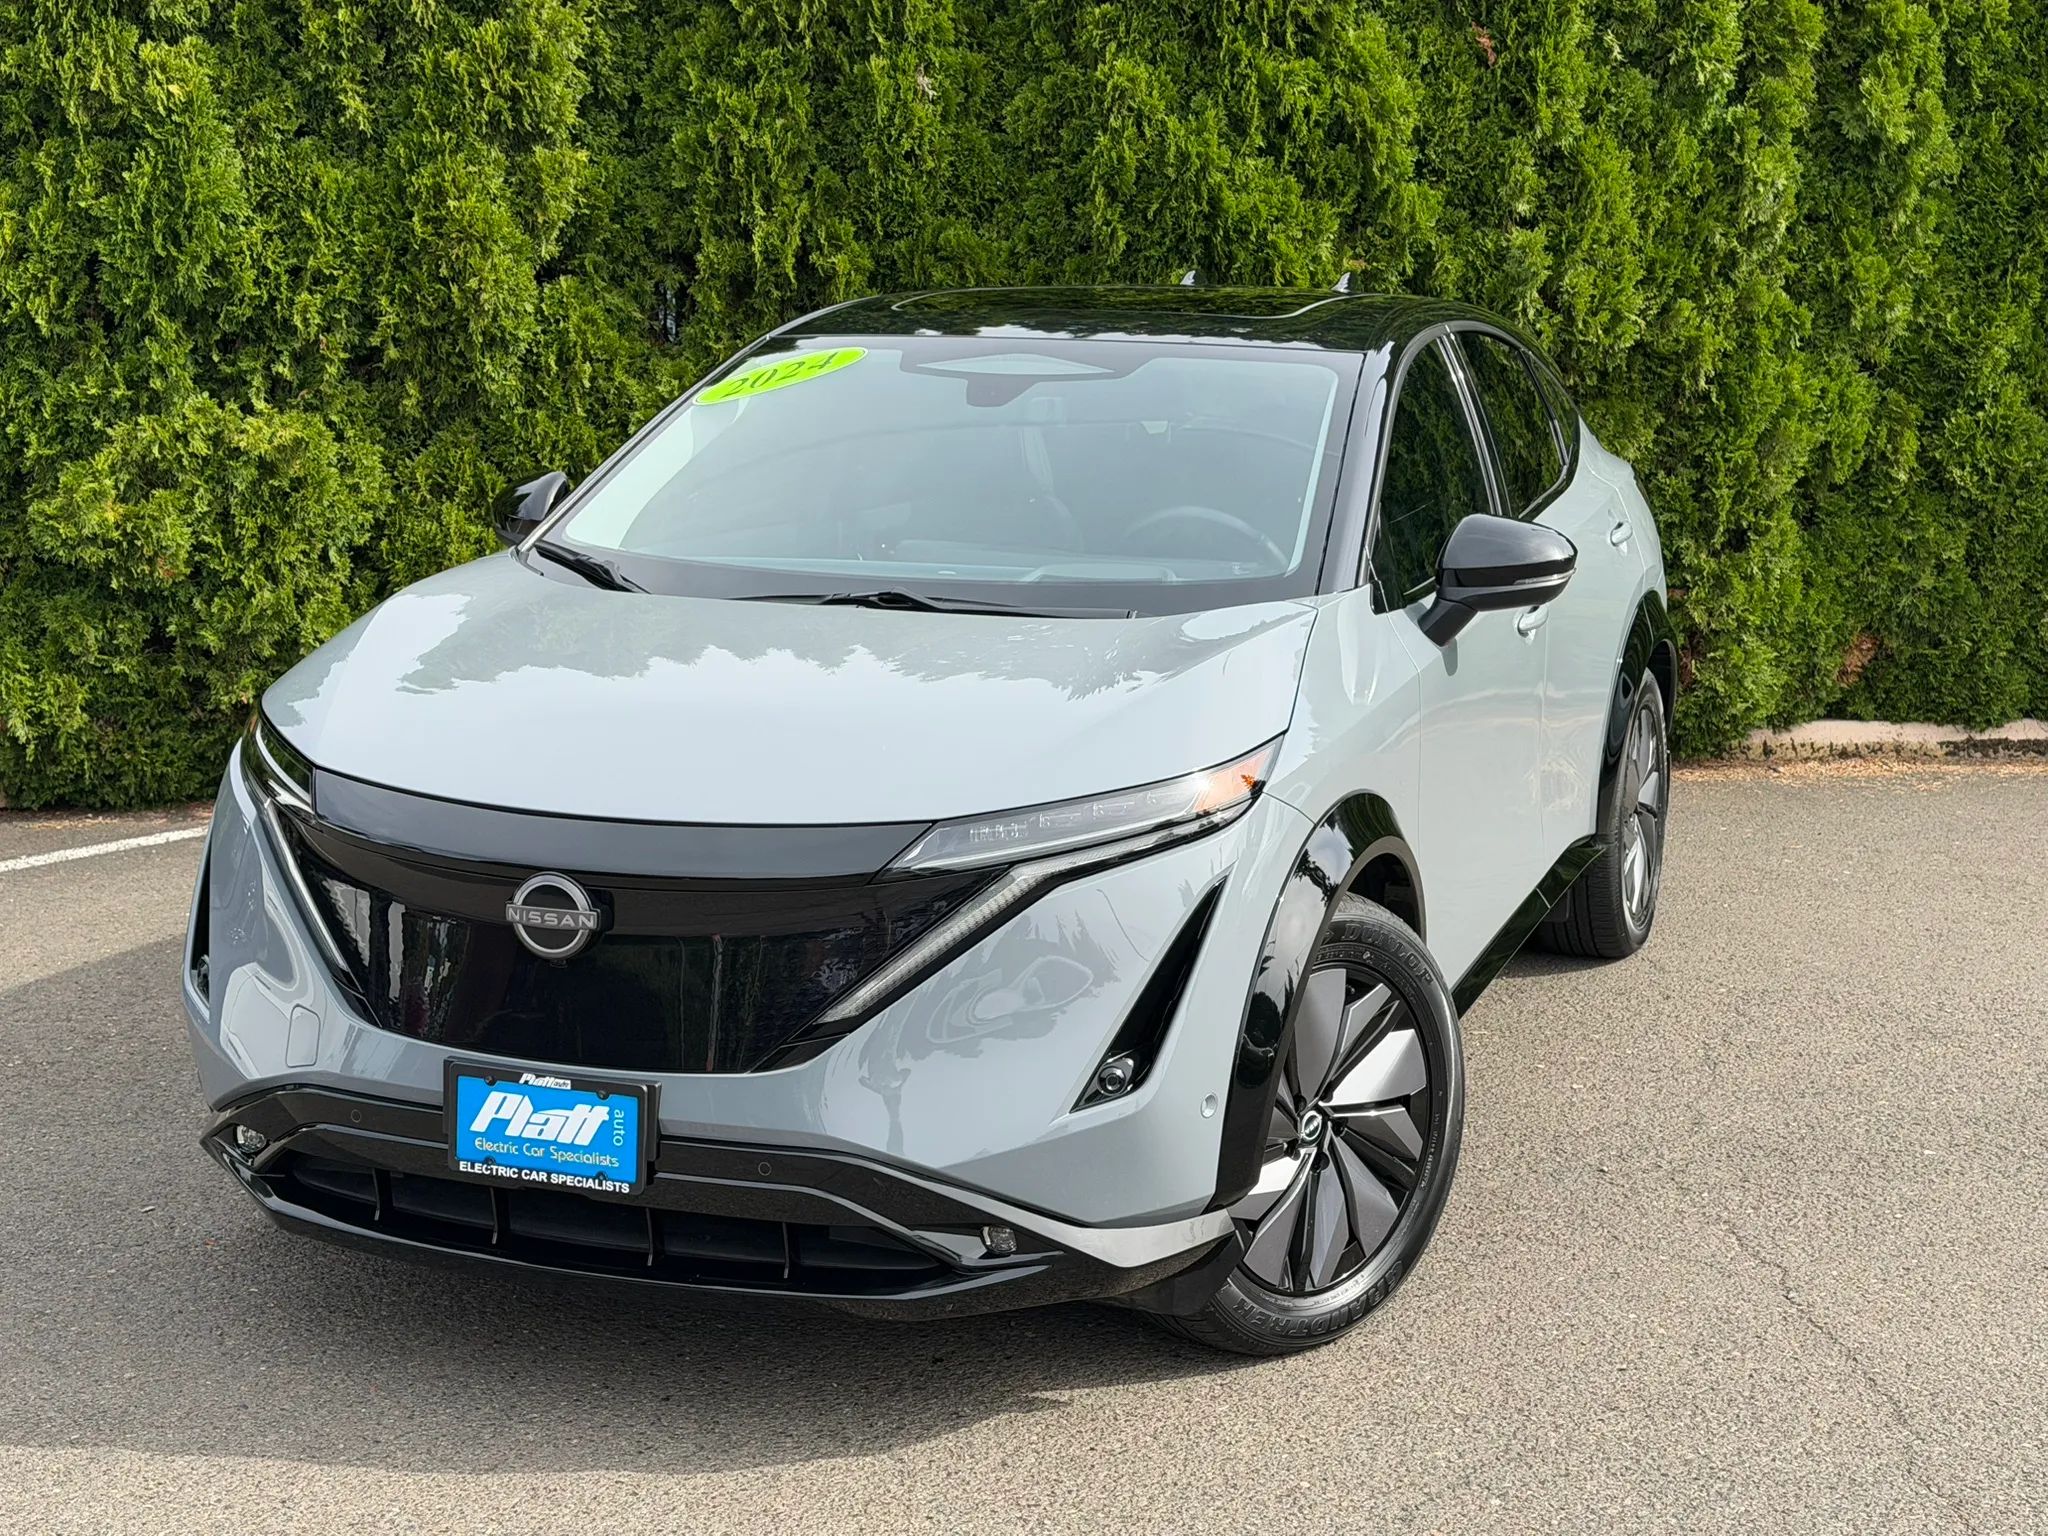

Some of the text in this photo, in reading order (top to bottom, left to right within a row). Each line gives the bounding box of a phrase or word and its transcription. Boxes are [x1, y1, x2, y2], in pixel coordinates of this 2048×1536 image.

[719, 351, 839, 399] 2024
[508, 906, 595, 929] NISSAN
[1340, 922, 1435, 985] DUNLOP
[519, 1072, 554, 1088] Platt
[469, 1090, 610, 1146] Platt
[613, 1108, 625, 1147] auto
[474, 1136, 620, 1168] Electric Car Specialists
[459, 1160, 630, 1194] ELECTRIC CAR SPECIALISTS
[1232, 1259, 1404, 1337] GRANDTREK
